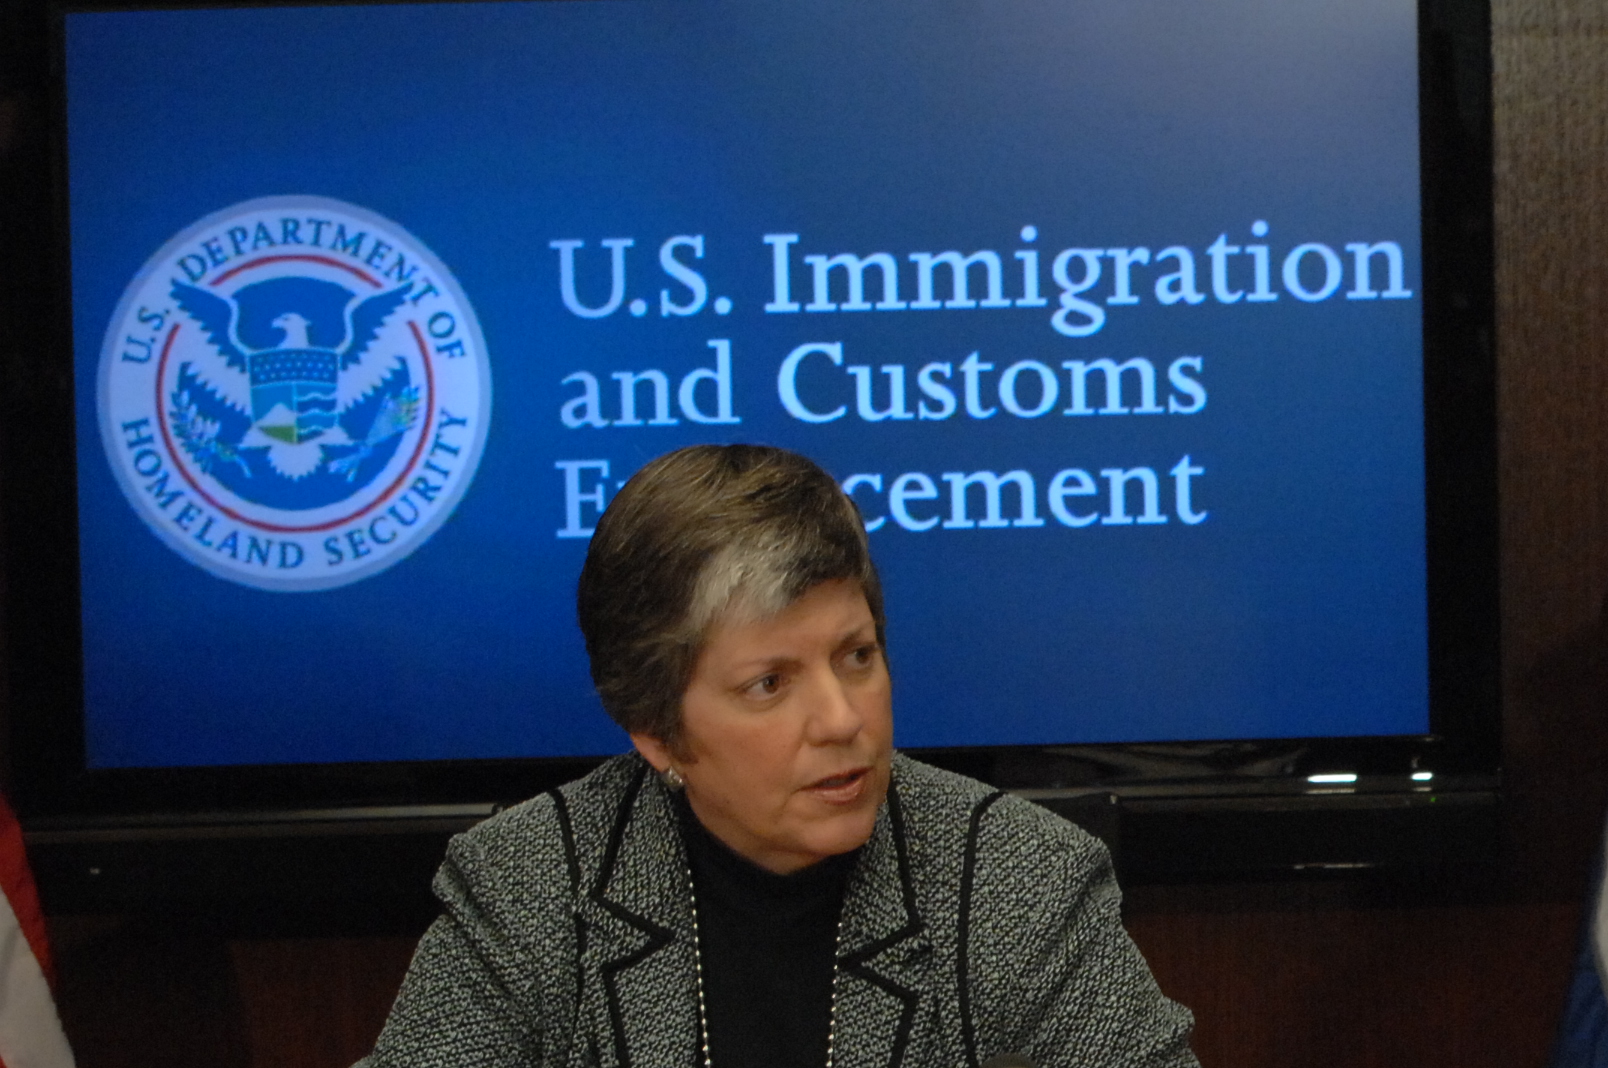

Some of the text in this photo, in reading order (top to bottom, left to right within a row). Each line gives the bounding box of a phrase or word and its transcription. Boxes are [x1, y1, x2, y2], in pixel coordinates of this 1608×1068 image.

[121, 217, 467, 364] U.S. DEPARTMENT OF
[549, 219, 1412, 337] U.S. Immigration
[559, 339, 1208, 428] and Customs
[121, 407, 468, 569] HOMELAND SECURITY
